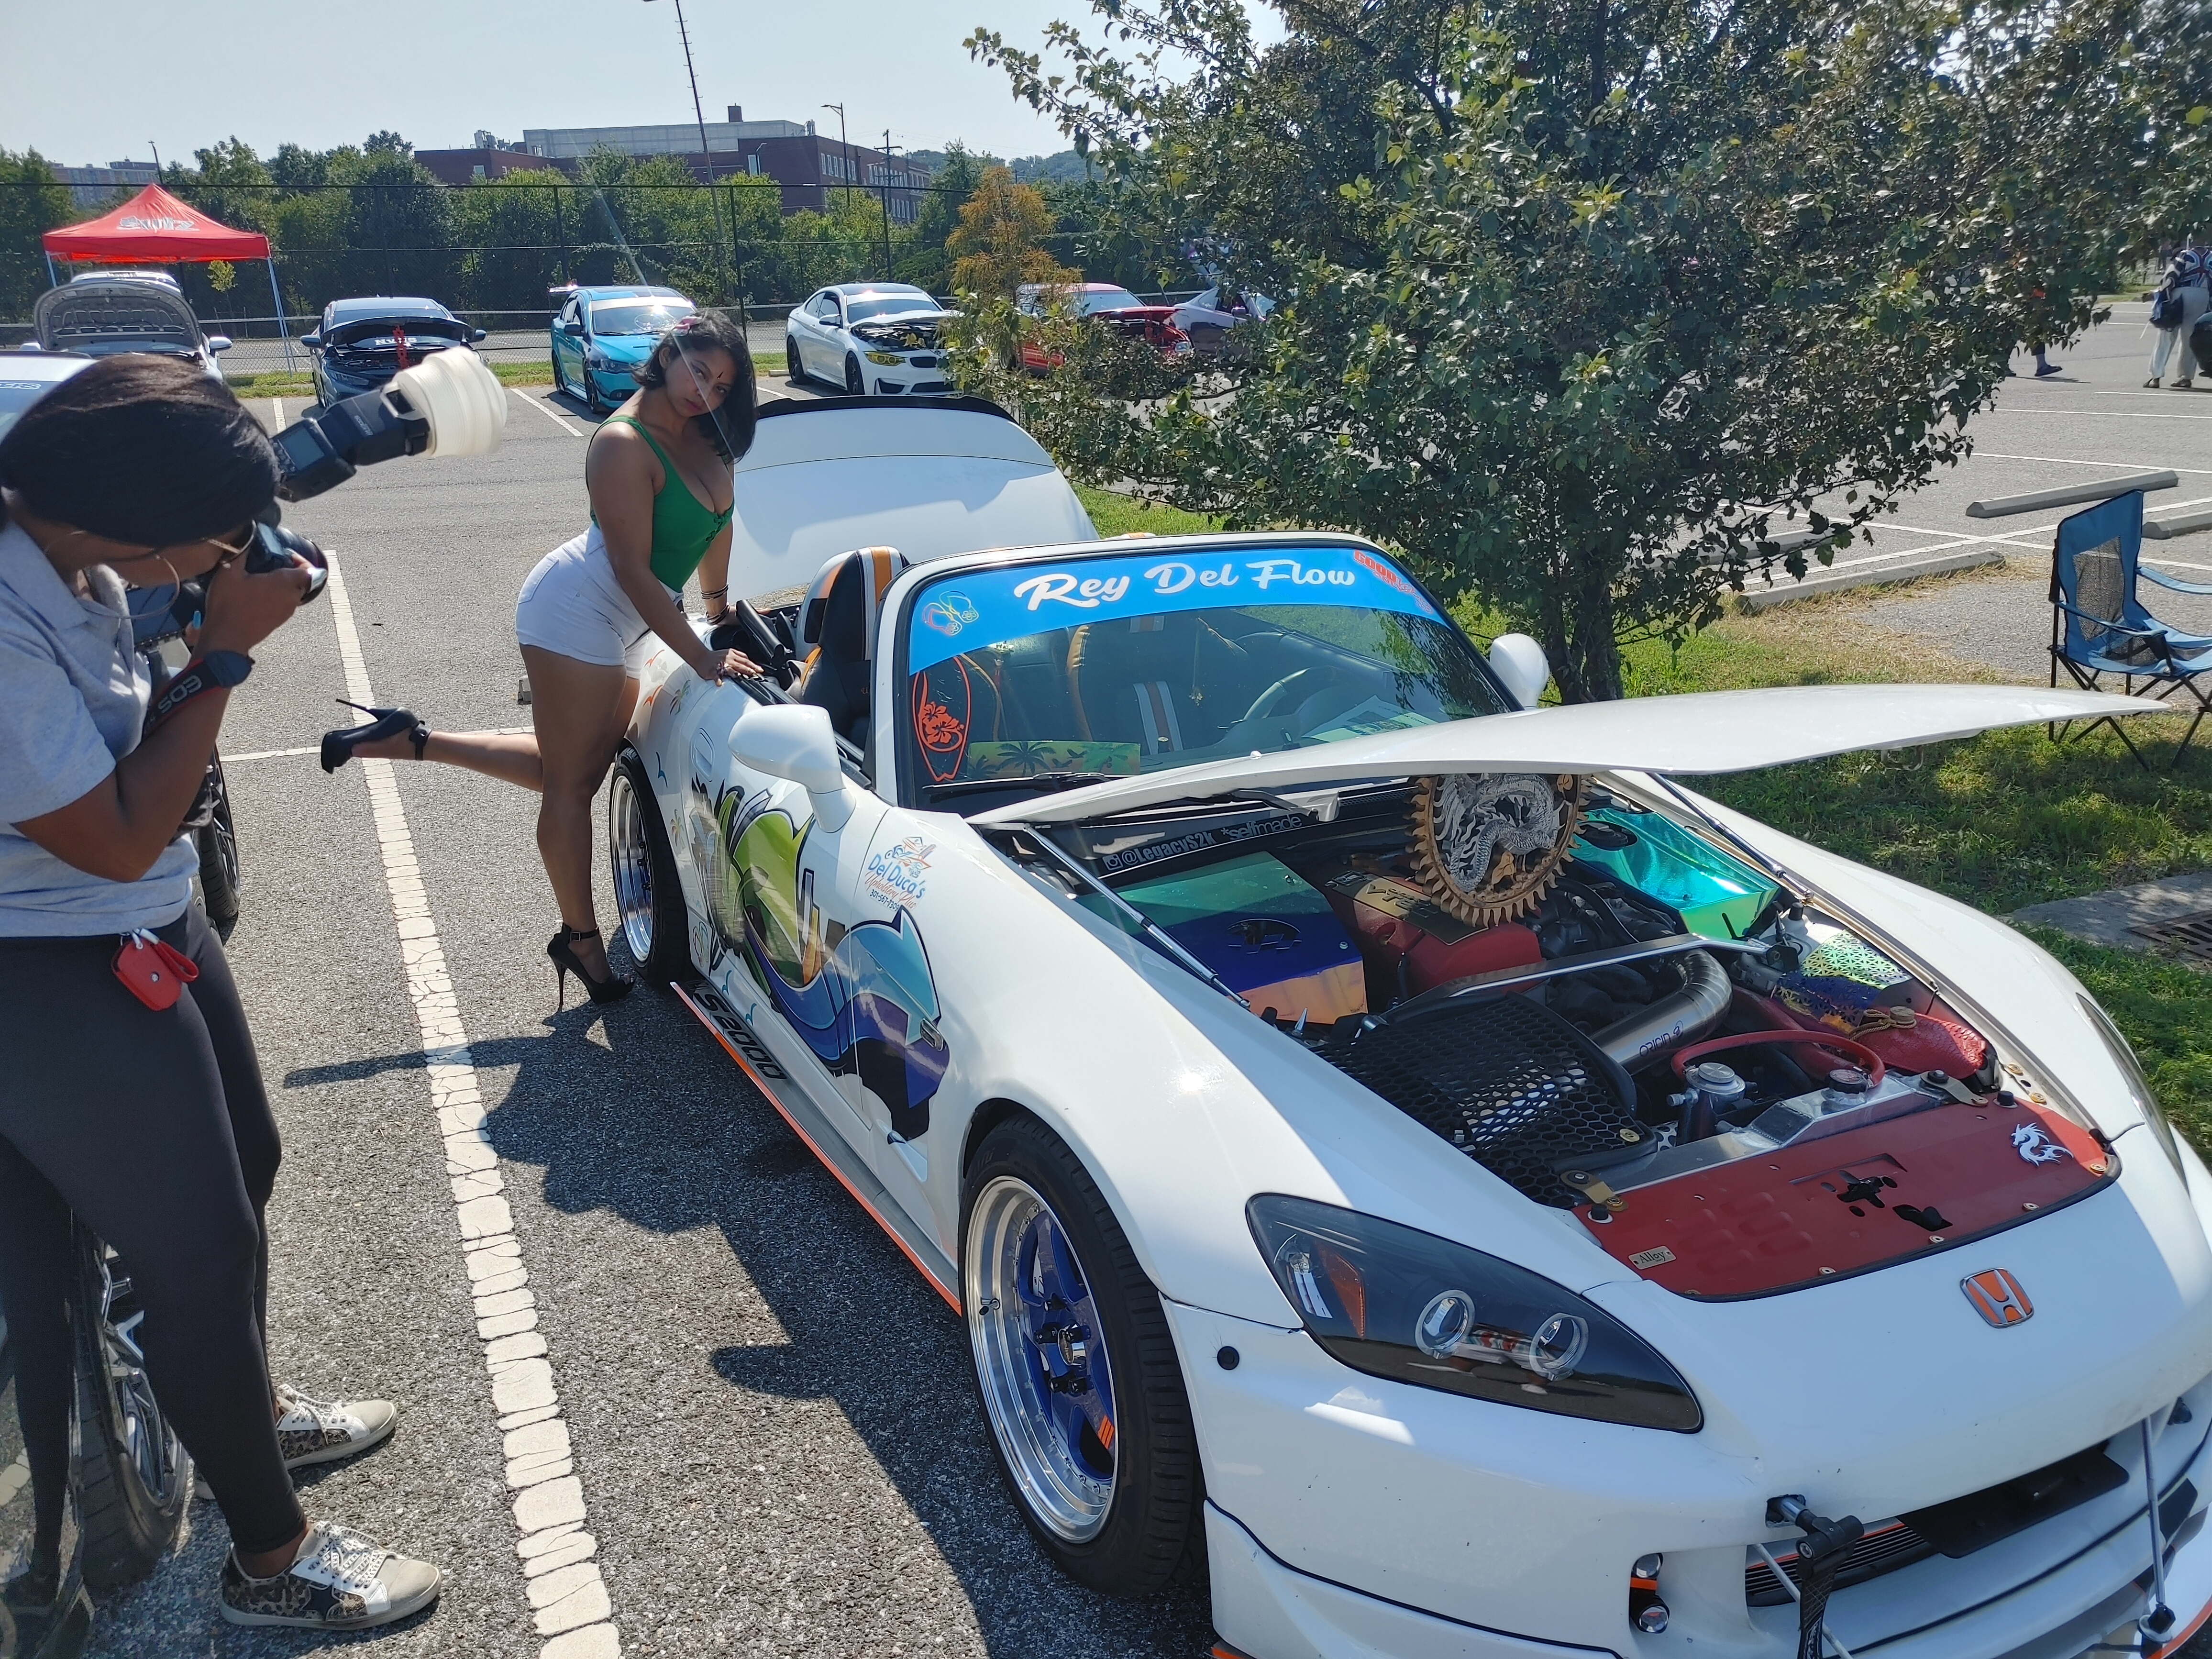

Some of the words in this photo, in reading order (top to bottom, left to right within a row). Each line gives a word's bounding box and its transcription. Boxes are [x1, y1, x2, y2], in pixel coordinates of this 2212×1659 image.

[1014, 574, 1130, 611] Rey
[1144, 562, 1239, 594] Del
[1245, 559, 1355, 589] Flow
[1354, 550, 1397, 583] GOOD
[158, 675, 202, 714] EOS
[1122, 831, 1217, 865] @LegacyS2k
[865, 870, 899, 900] Upholstery
[896, 891, 917, 909] Plus
[868, 853, 893, 877] Del
[887, 865, 926, 899] Duca's
[693, 993, 787, 1079] S2000
[1639, 1251, 1666, 1263] Alloy
